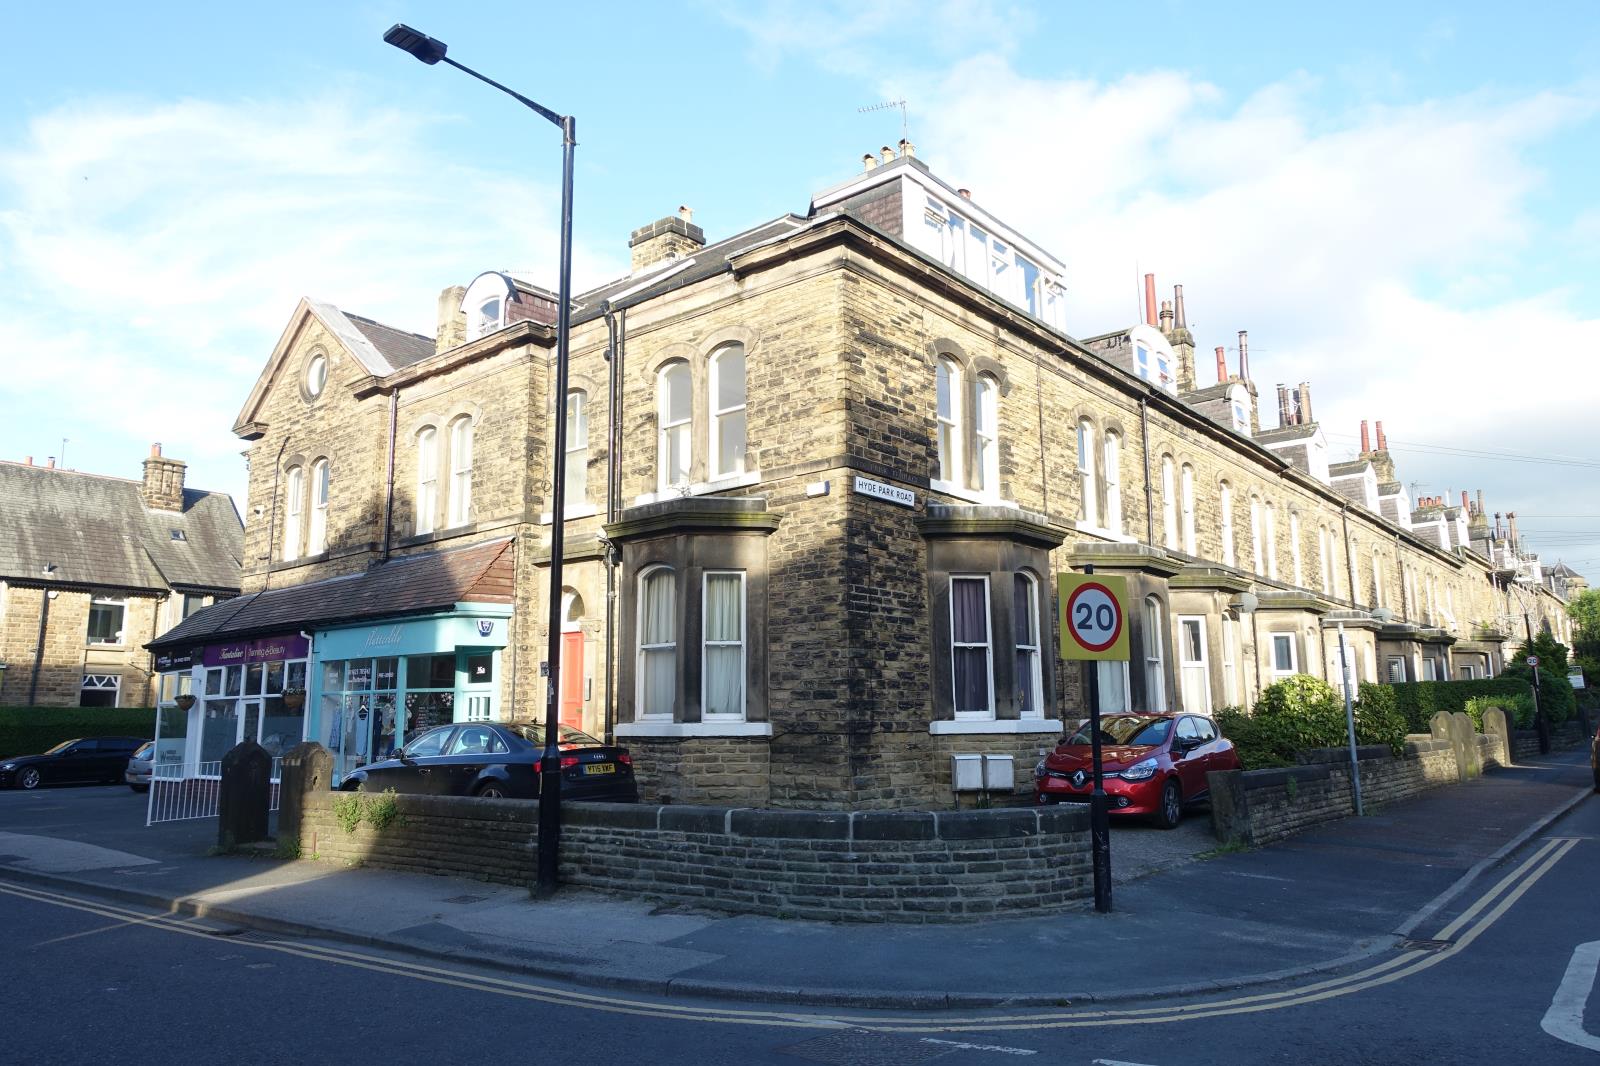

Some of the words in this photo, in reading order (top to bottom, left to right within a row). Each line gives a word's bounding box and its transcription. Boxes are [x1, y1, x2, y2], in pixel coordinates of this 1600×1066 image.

[858, 480, 876, 493] HYDE
[878, 486, 895, 497] PARK
[896, 490, 913, 503] ROAD
[1075, 602, 1114, 631] 20
